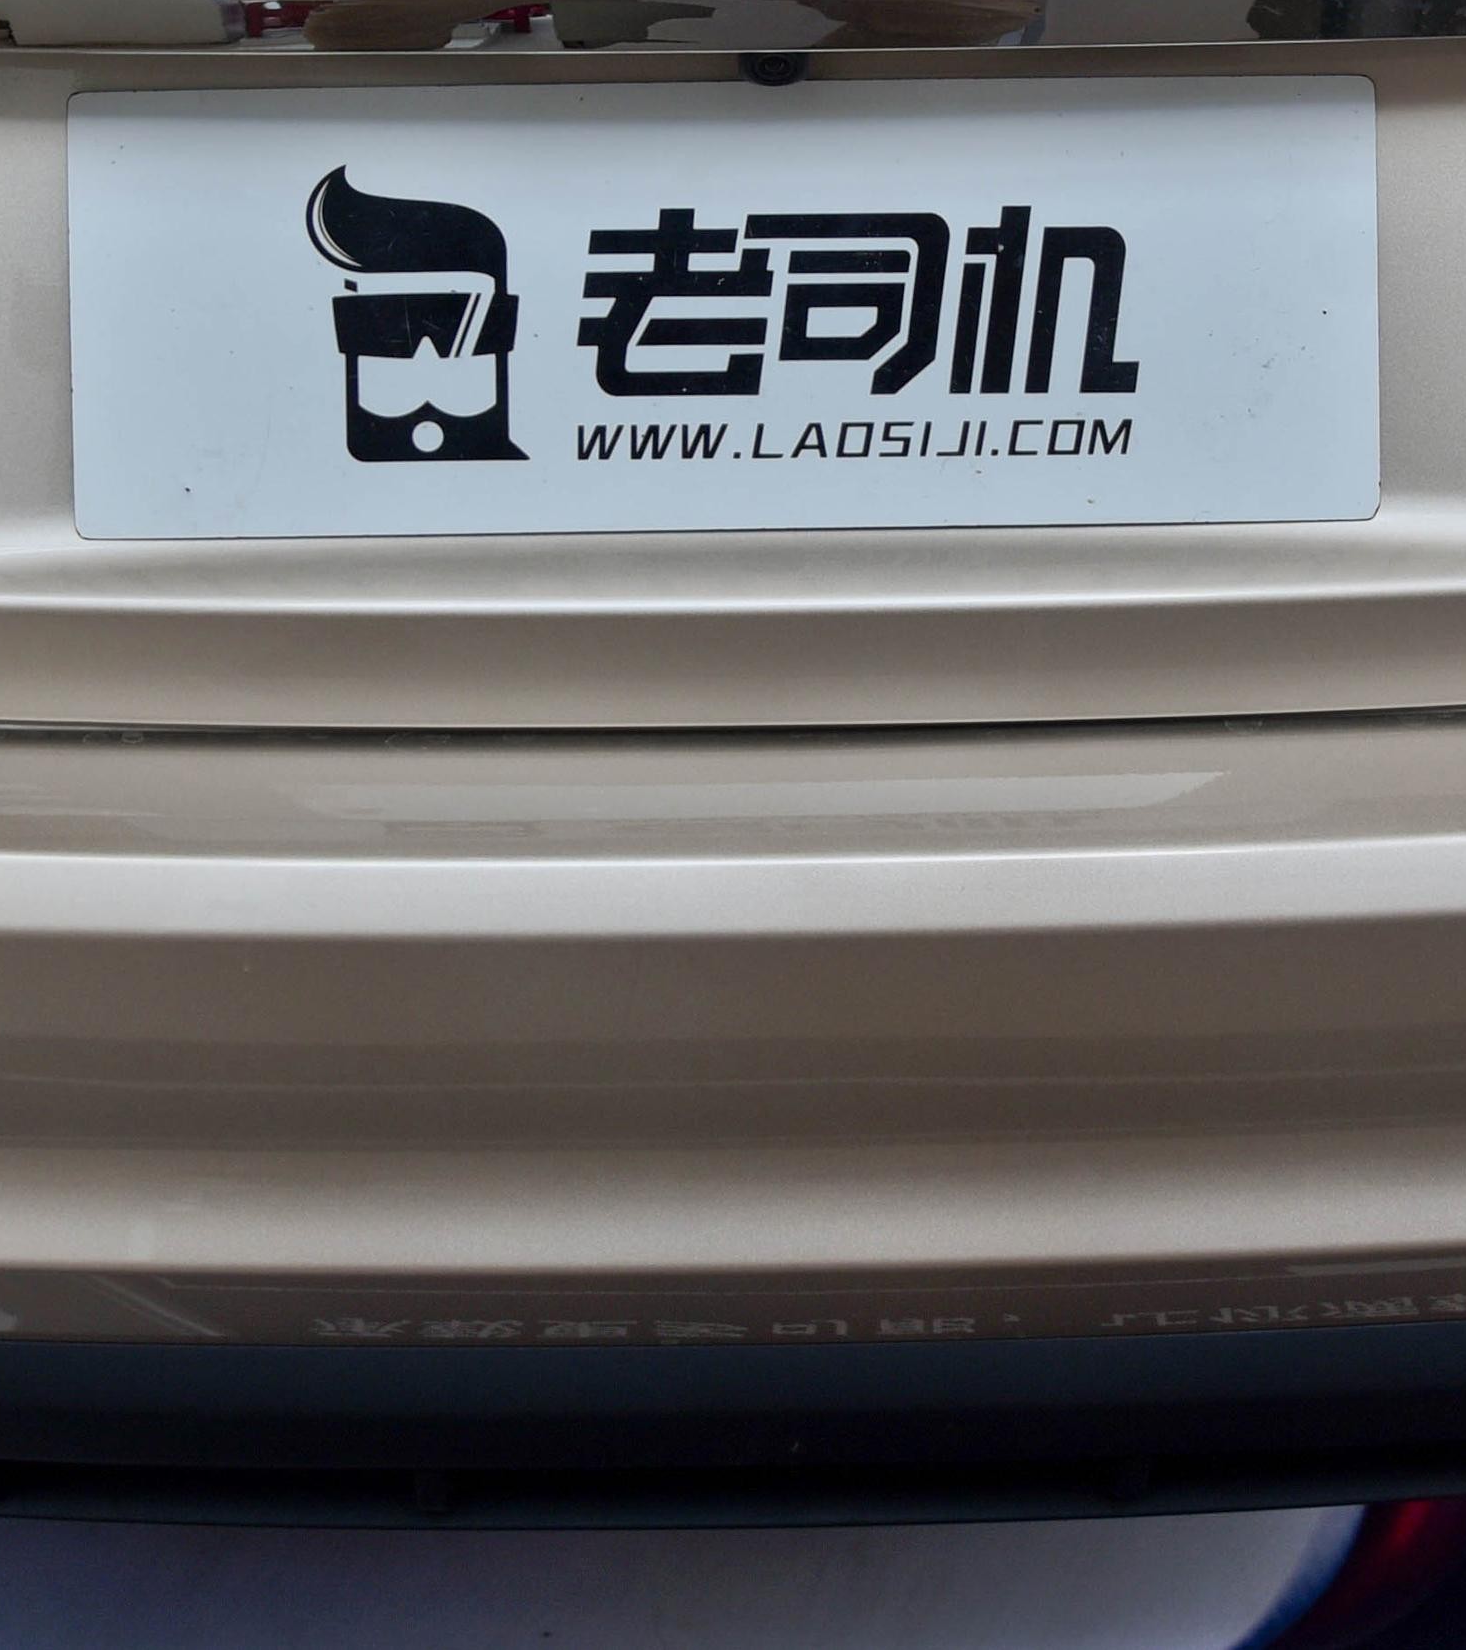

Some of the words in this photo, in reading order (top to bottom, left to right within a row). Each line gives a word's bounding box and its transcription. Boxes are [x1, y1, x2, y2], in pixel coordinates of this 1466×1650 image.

[577, 205, 1140, 397] 老司机
[577, 417, 1133, 461] WWW.LAOSIJI.COM
